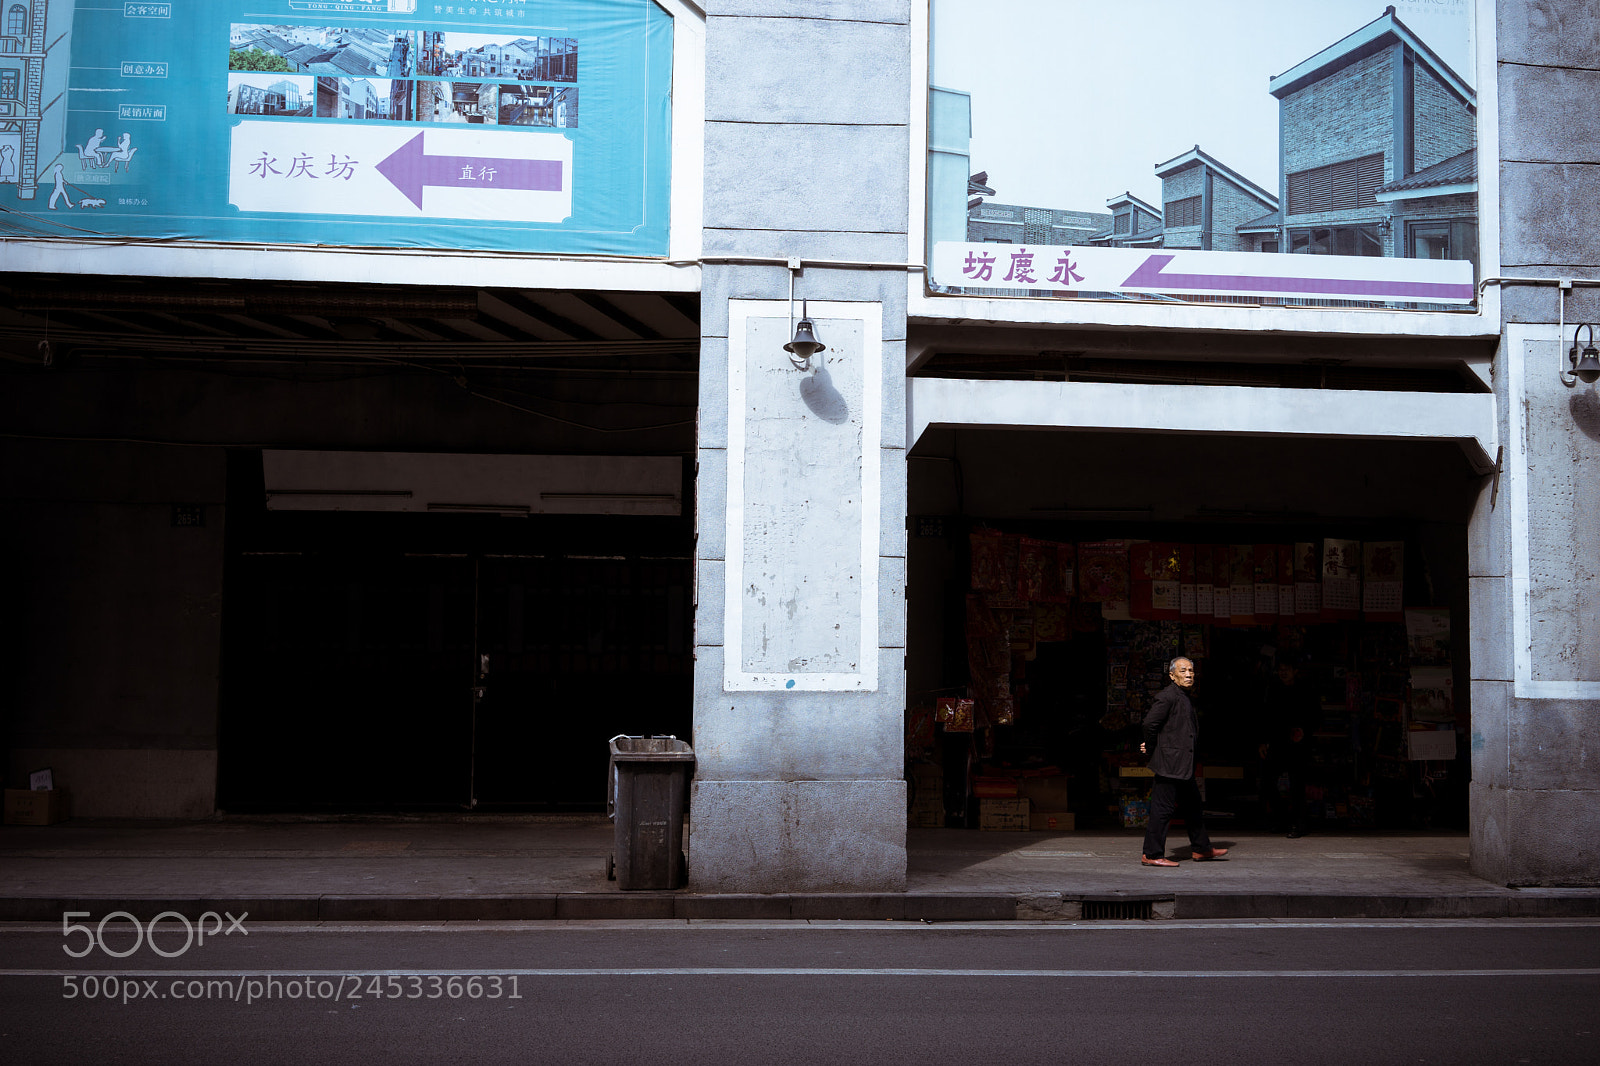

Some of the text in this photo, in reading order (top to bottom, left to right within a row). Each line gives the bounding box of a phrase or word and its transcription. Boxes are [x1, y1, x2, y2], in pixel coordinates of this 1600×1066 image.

[126, 5, 168, 16] 会客空间
[123, 64, 165, 75] 创意办公
[120, 107, 163, 118] 展销店面
[248, 151, 359, 181] 永庆坊
[458, 164, 498, 182] 直行
